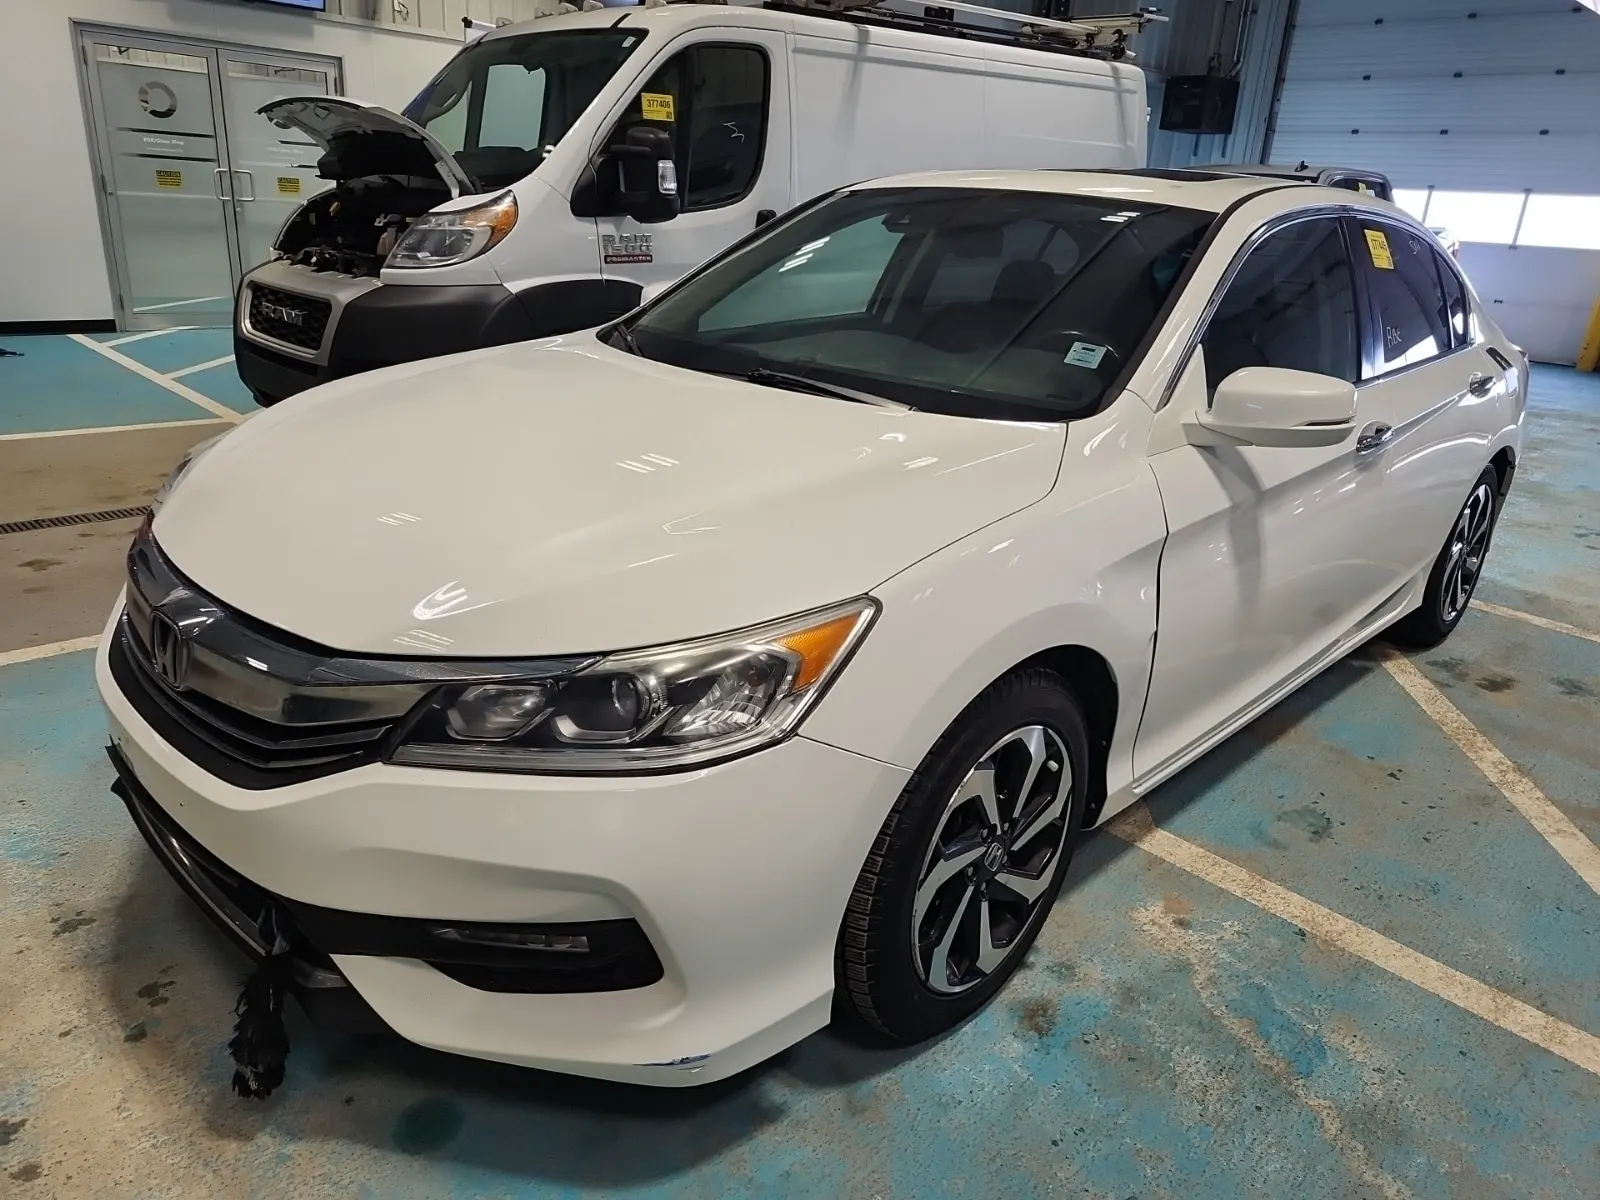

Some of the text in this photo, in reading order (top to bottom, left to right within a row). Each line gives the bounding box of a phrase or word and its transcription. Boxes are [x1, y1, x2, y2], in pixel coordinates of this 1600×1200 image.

[646, 98, 671, 109] 377406
[601, 233, 652, 245] RAM
[603, 243, 652, 254] 1500
[261, 302, 308, 327] RAM
